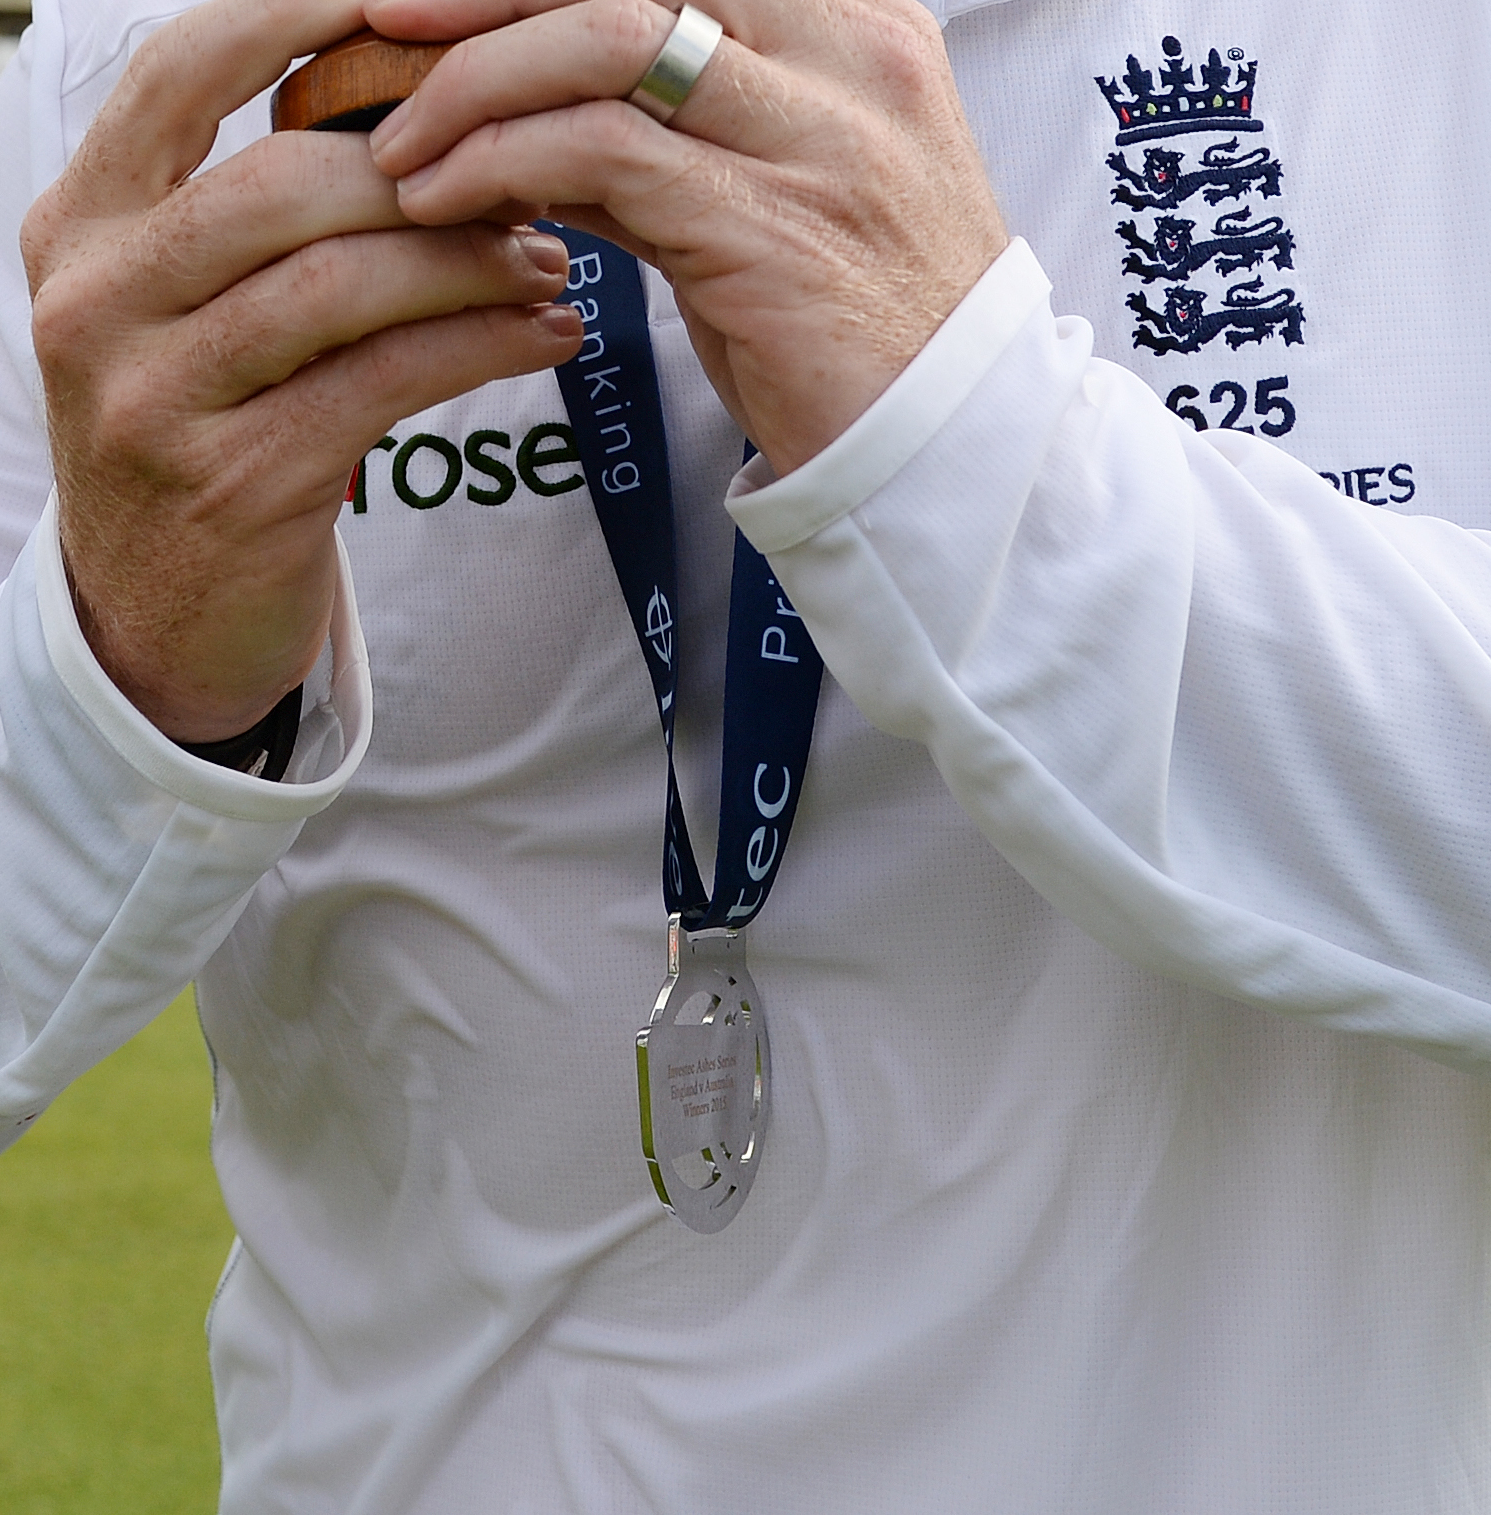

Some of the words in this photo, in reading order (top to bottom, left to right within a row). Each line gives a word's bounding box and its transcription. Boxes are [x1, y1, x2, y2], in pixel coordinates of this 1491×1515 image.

[565, 251, 641, 495] Banking
[1165, 375, 1297, 438] 625
[712, 1096, 727, 1113] 2015
